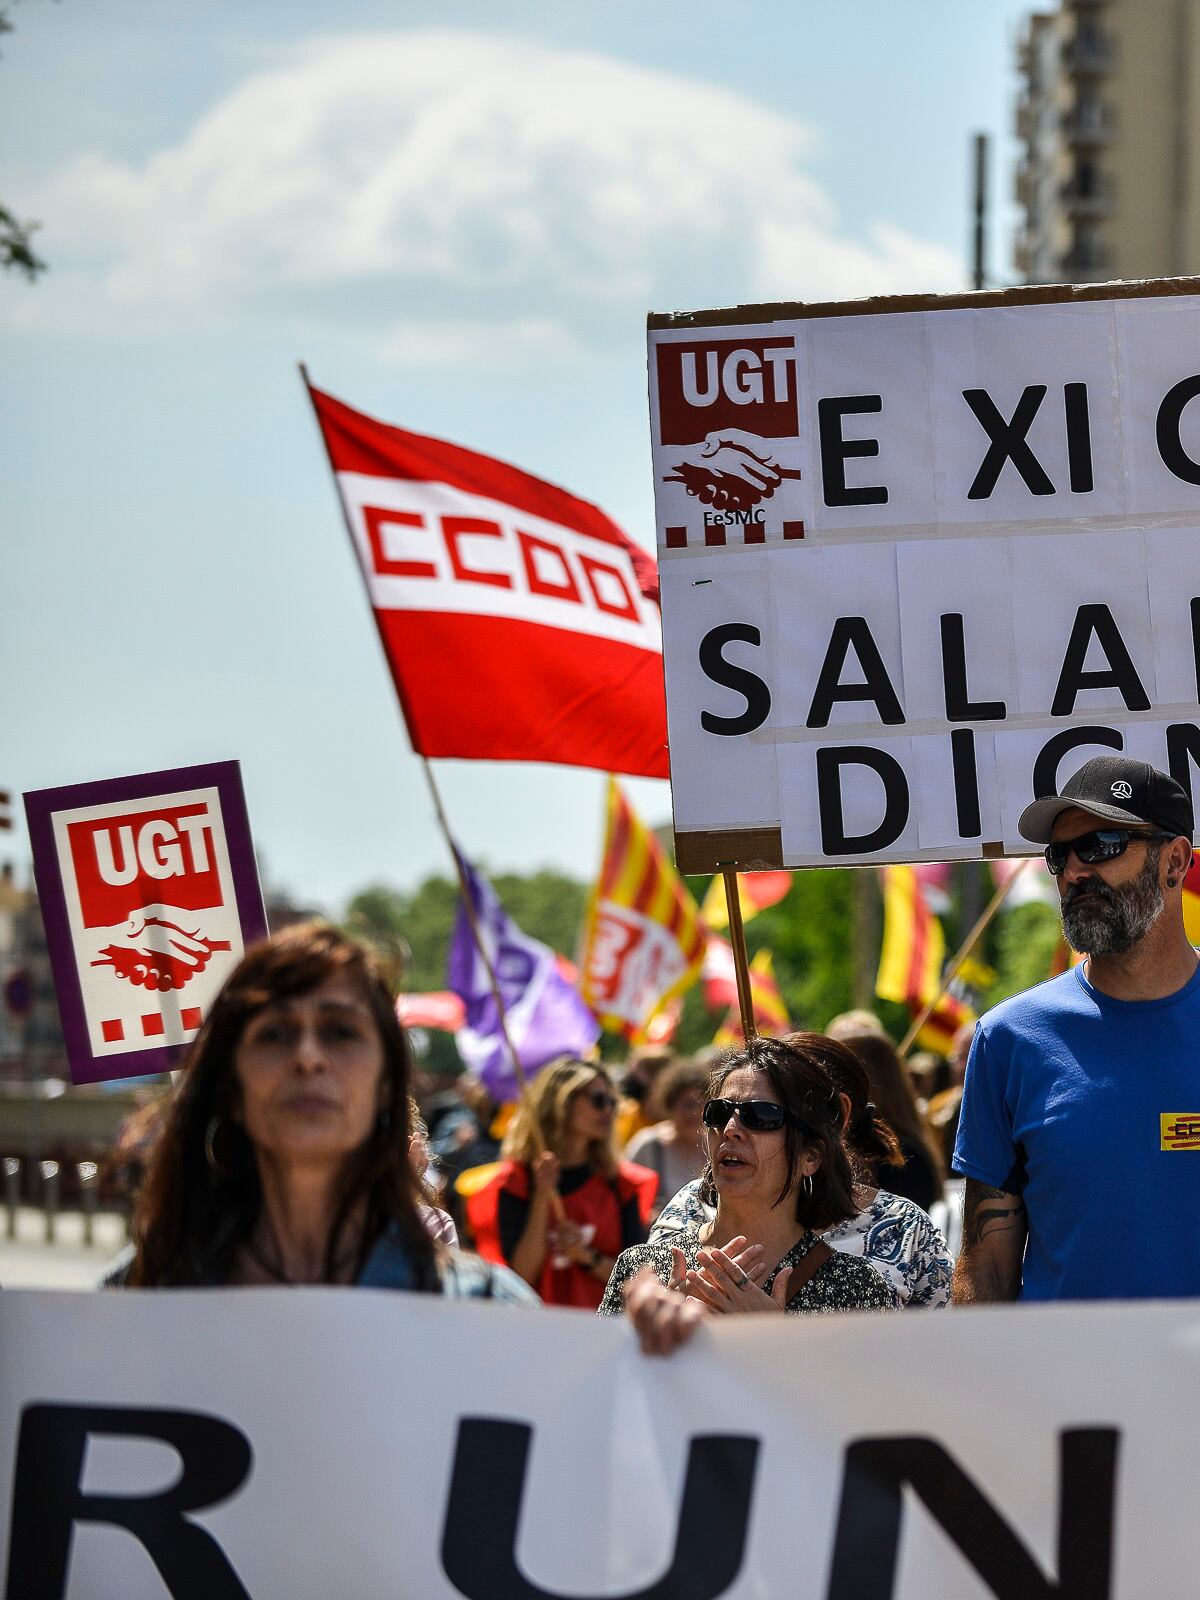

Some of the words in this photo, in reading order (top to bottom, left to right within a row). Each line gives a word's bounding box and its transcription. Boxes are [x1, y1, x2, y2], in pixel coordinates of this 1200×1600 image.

[681, 347, 797, 408] UGT
[703, 508, 767, 527] FeSMC
[361, 505, 643, 625] CCOO
[92, 813, 211, 887] UGT
[439, 1413, 1122, 1600] UN
